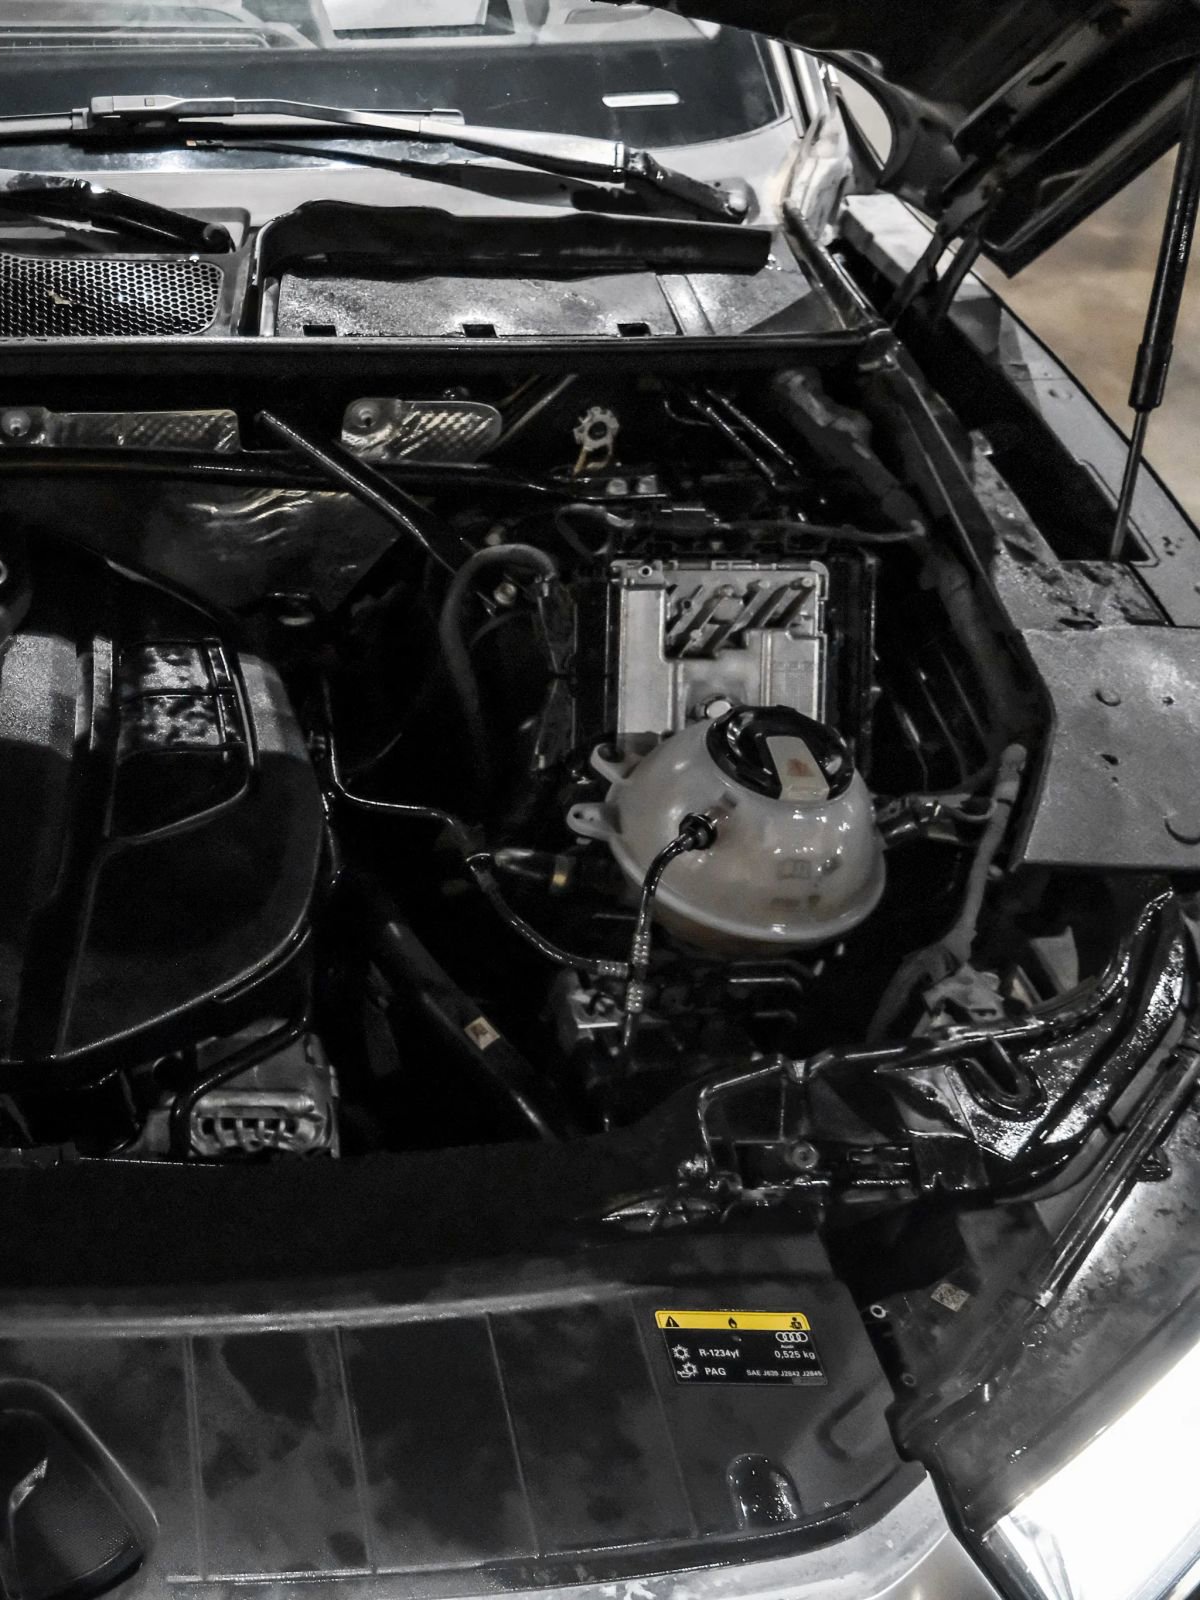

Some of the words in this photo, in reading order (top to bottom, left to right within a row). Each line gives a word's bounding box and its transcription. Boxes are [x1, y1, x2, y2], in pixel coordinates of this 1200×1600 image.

[698, 1348, 739, 1358] R-1234yf
[774, 1350, 801, 1359] 0,525
[802, 1350, 816, 1360] kg
[704, 1367, 726, 1376] PAG
